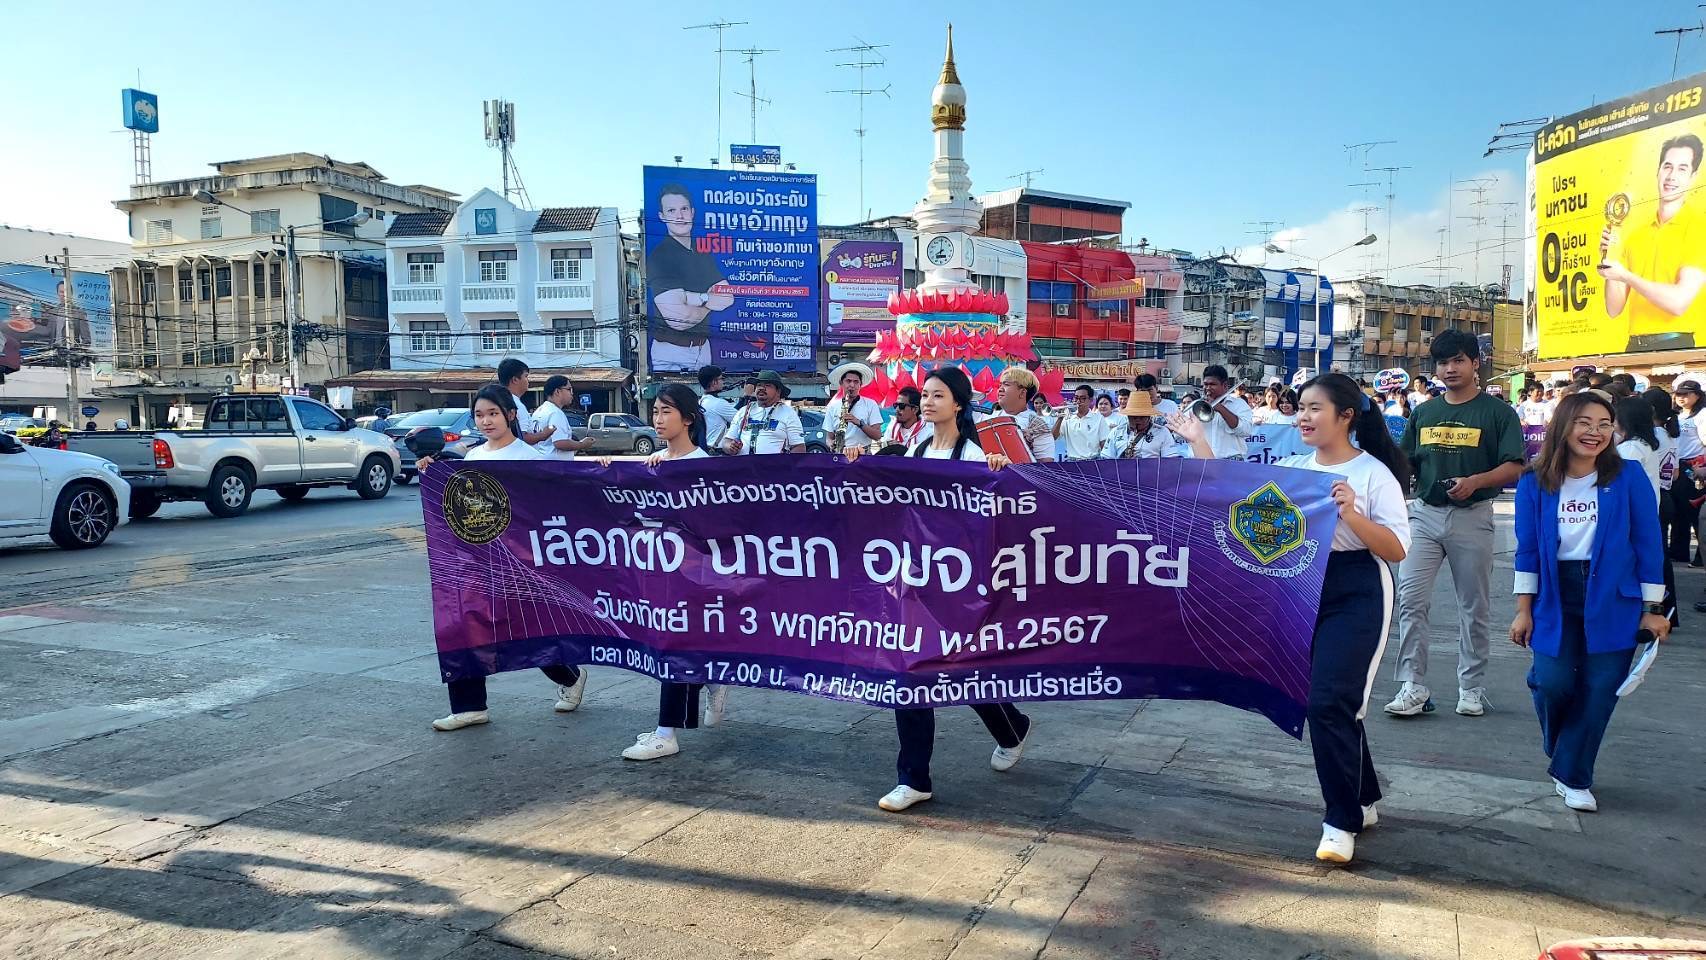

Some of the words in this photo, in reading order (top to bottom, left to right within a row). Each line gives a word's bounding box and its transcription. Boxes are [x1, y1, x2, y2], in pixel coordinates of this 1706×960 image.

[1665, 86, 1703, 114] 1153
[1552, 176, 1576, 194] โปรฯ
[703, 188, 808, 208] ทดสอบวัดระดับ
[1545, 192, 1588, 218] มหาชน
[704, 208, 809, 237] ภาษาอังกฤษ
[736, 239, 813, 254] กับเจ้าของภาษา
[1562, 231, 1587, 251] ผ่อน
[1562, 253, 1591, 271] ทั้งร้าน
[1544, 295, 1561, 308] นาน
[602, 477, 1037, 517] เชิญชวนพี่น้องชาวสุโขทัยออกมาใช้สิทธิ
[1561, 499, 1596, 512] เลือก
[529, 512, 685, 573] เลือกตั้ง
[706, 534, 840, 580] นายก
[863, 525, 1190, 602] อบจ.สุโขทัย
[592, 589, 690, 633] วันอาทิตย์
[703, 595, 725, 633] ที่
[739, 606, 758, 635] 3
[770, 611, 924, 653] พฤศจิกายน
[939, 614, 1109, 657] พ.ศ.2567
[590, 645, 622, 665] เวลา
[626, 650, 656, 674] 08.00
[657, 660, 675, 680] น.
[704, 660, 762, 684] 17.00
[769, 666, 787, 687] น.
[802, 671, 824, 692] ณ
[828, 666, 1123, 706] หน่วยเลือกตั้งที่ท่านมีรายชื่อ
